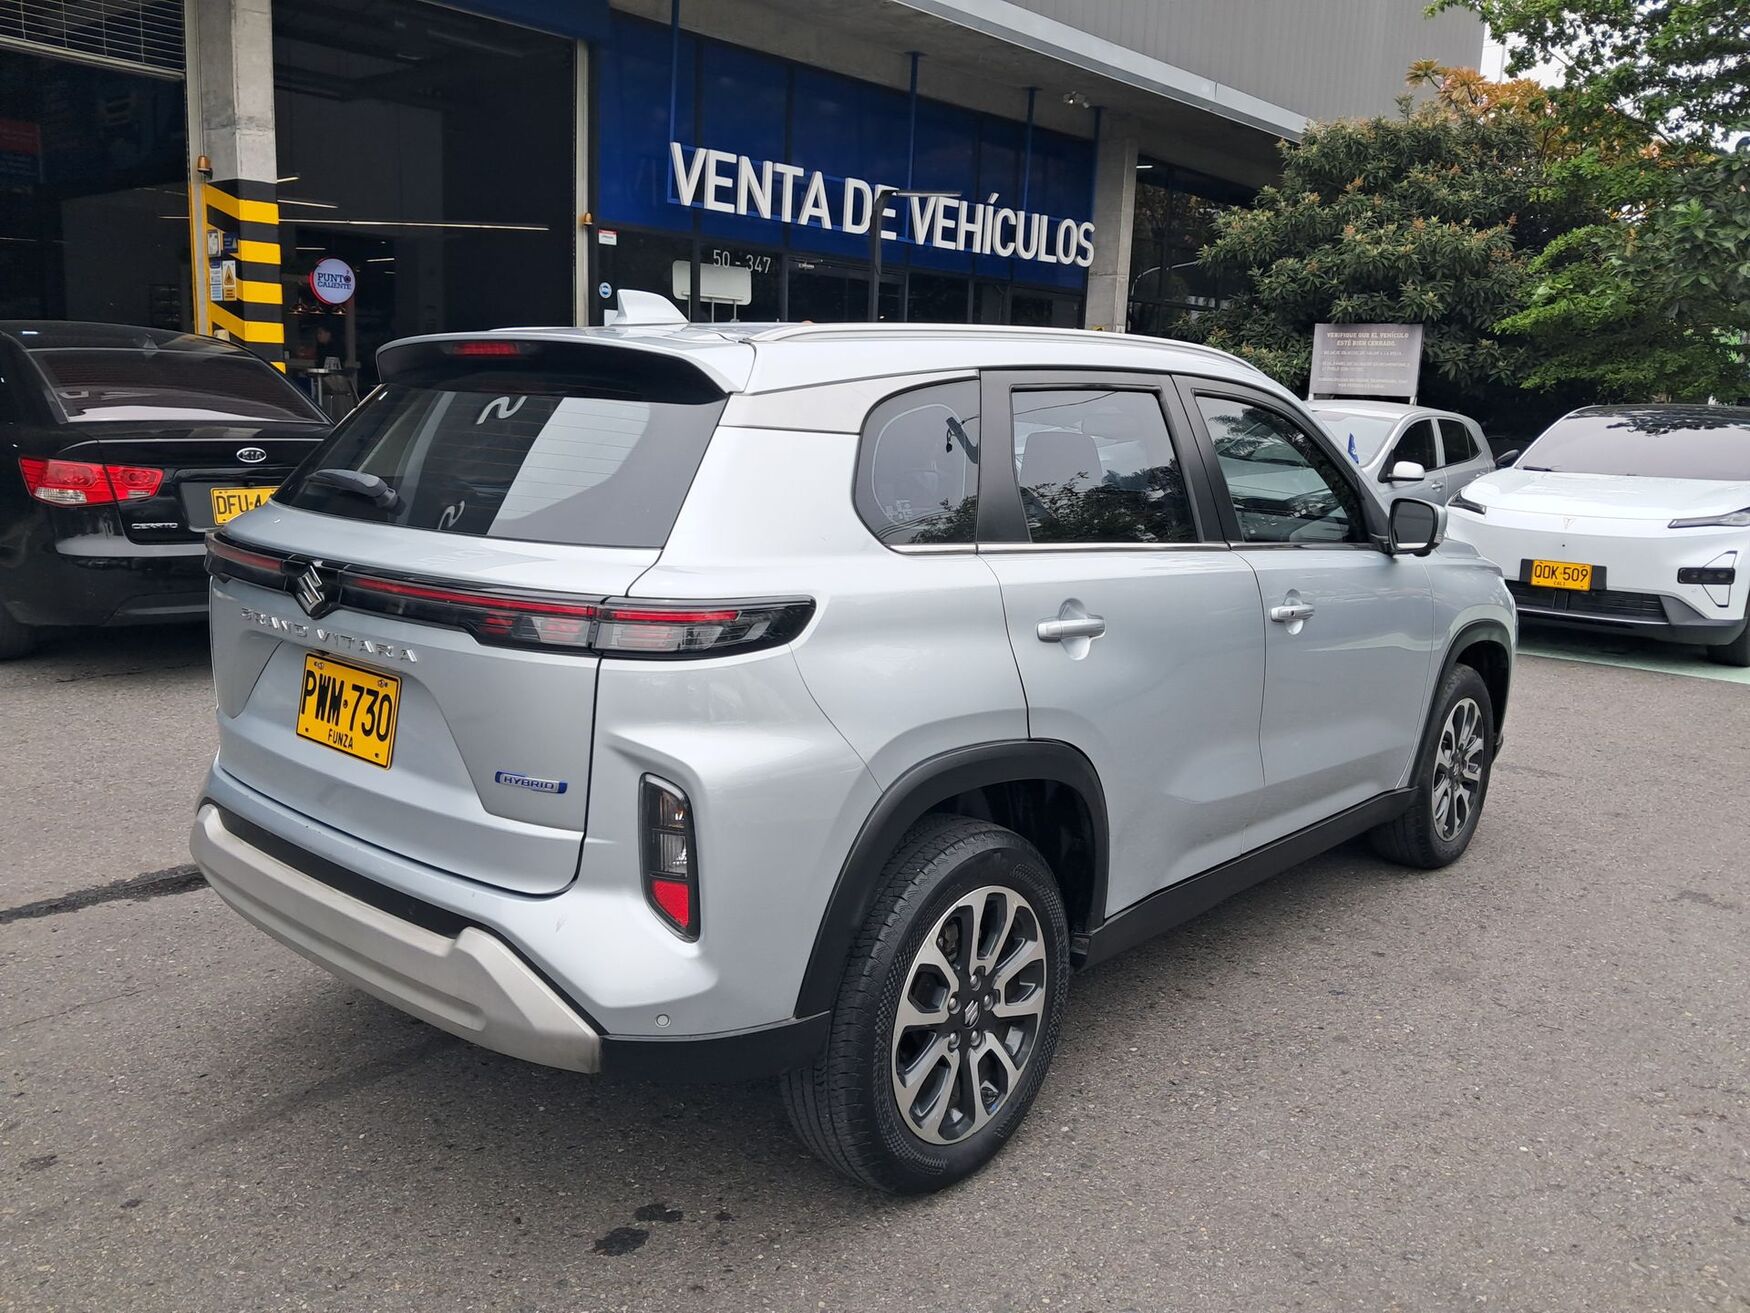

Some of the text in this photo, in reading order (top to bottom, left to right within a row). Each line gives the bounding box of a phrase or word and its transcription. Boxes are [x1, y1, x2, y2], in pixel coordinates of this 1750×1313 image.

[670, 142, 1096, 268] VENTA DE VEHÍCULOS
[713, 249, 730, 268] 50
[746, 254, 772, 274] 347
[317, 272, 351, 283] PUNTO
[317, 281, 351, 290] CALIENTE
[241, 607, 418, 663] GRAND VITARA
[327, 728, 354, 750] FUNZA
[503, 775, 555, 790] HYBRID
